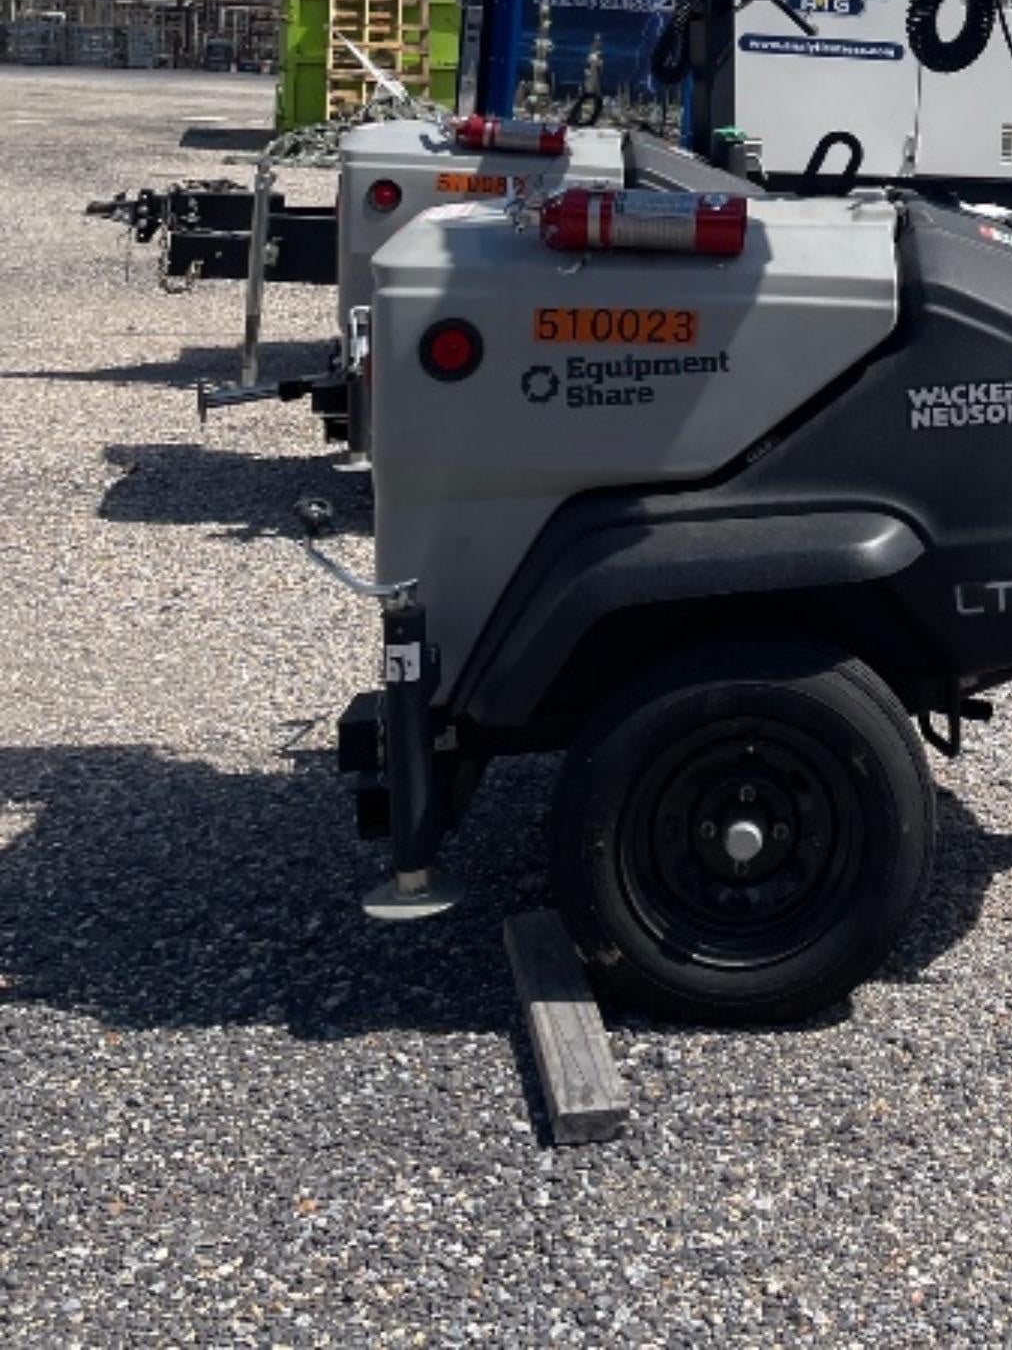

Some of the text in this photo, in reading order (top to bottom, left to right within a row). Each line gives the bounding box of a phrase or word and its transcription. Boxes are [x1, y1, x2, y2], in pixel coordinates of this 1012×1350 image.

[538, 308, 694, 343] 510023
[566, 350, 730, 385] Equipment
[566, 385, 655, 408] Share
